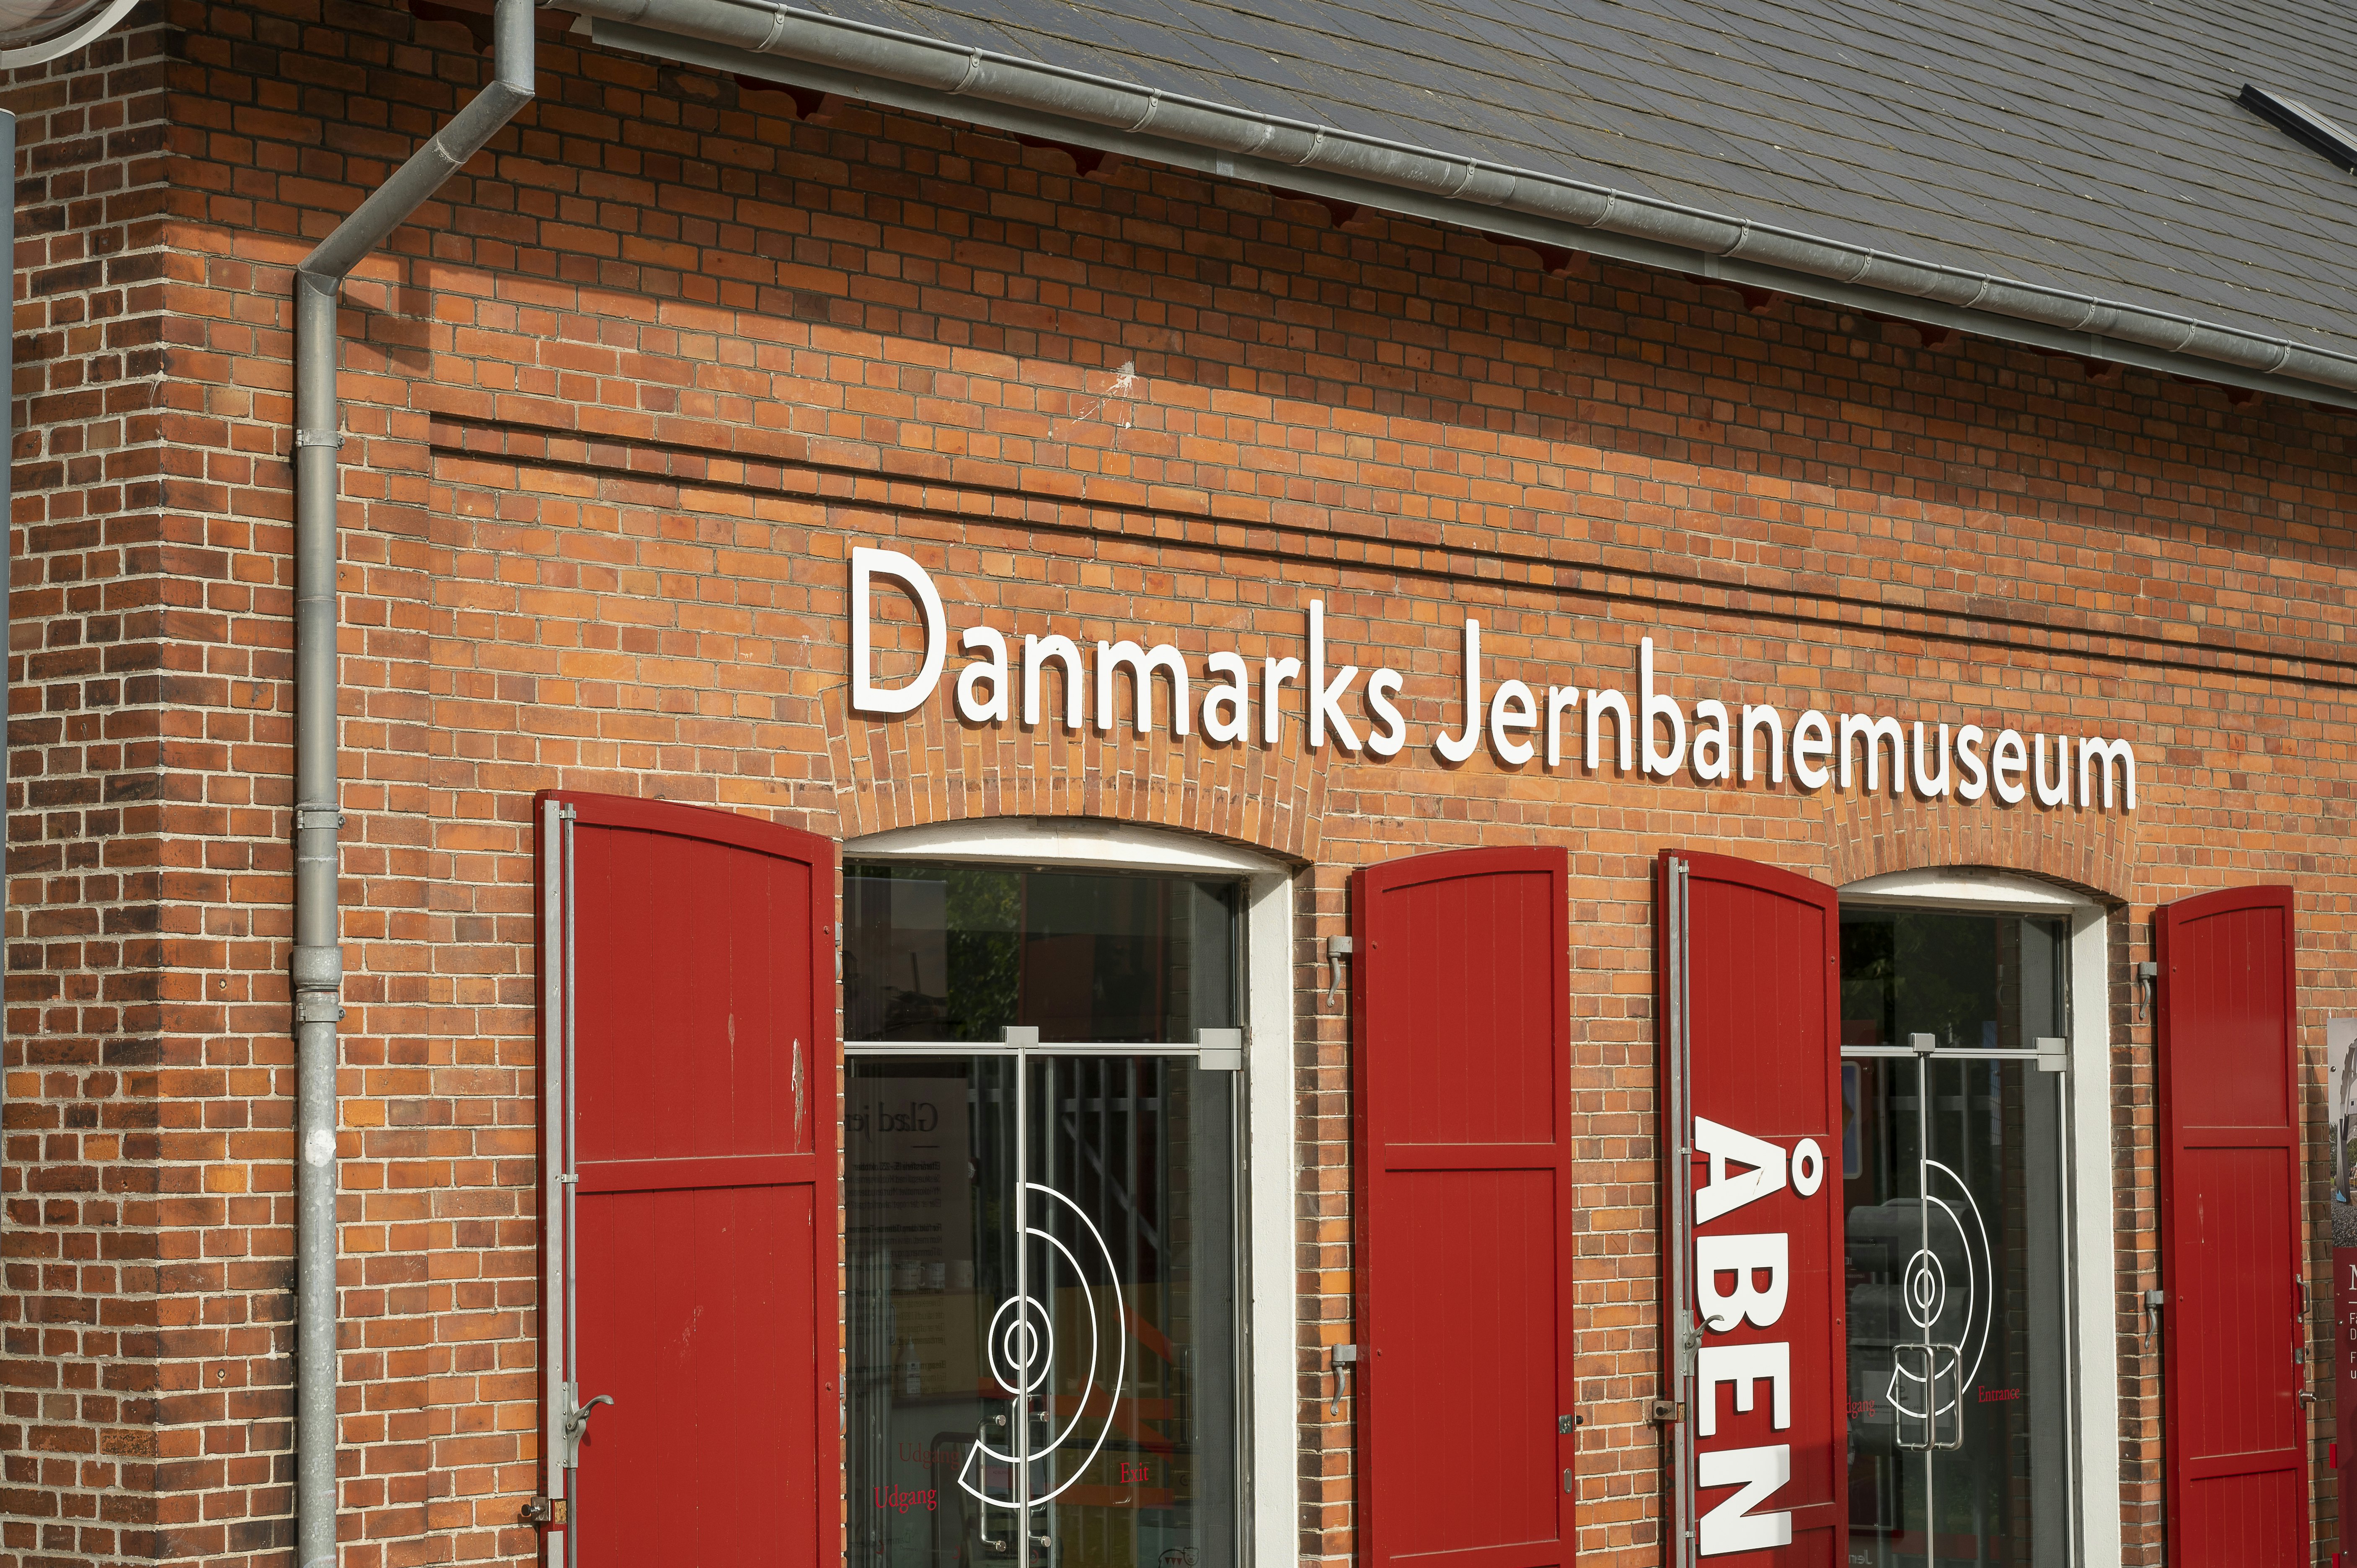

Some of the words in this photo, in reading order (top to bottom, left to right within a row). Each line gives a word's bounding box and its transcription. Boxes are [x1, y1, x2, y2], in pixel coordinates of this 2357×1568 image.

[852, 545, 1406, 756] Danmarks
[1435, 618, 2136, 810] Jernbanemuseum
[1695, 1115, 1824, 1556] ÅBEN
[1846, 1395, 1876, 1419] dgang
[1978, 1386, 2020, 1403] Entrance
[1120, 1462, 1149, 1483] Exit
[874, 1484, 937, 1514] Udgang
